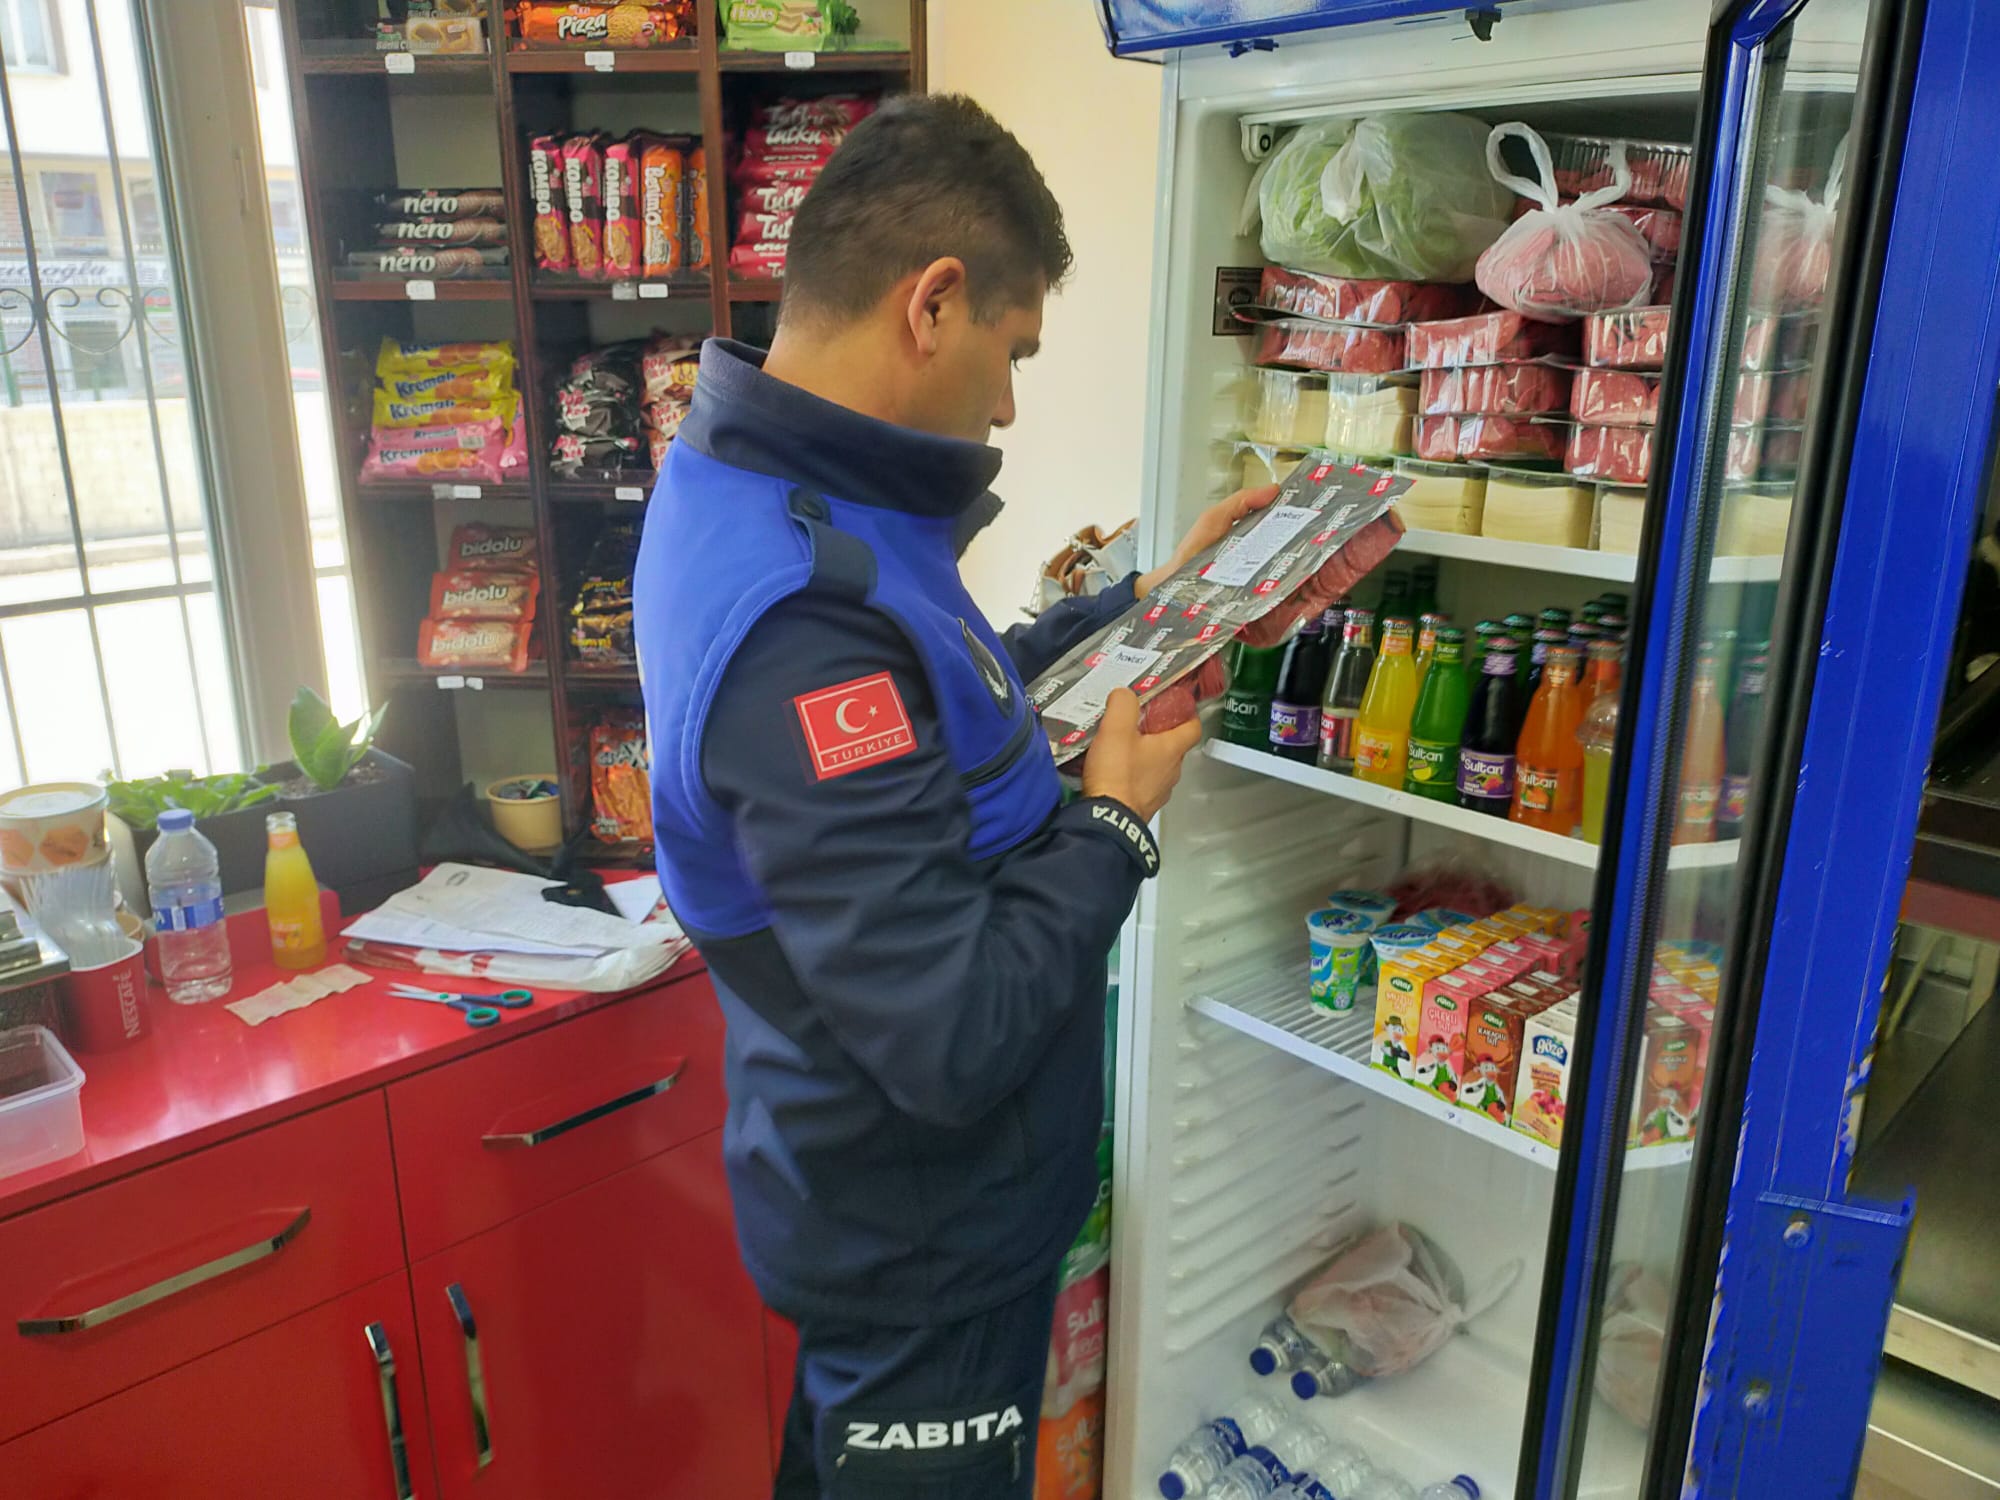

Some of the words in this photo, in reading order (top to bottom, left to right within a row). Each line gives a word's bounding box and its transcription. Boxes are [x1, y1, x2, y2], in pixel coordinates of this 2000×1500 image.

[557, 13, 607, 40] Pizza
[531, 149, 552, 215] KOMBO
[565, 157, 584, 224] KOMBO
[605, 157, 622, 222] KOMBO
[403, 197, 459, 214] nero
[756, 186, 806, 212] Tutk
[397, 222, 455, 240] nero
[379, 254, 437, 273] nero
[461, 537, 523, 557] bidolu
[443, 584, 508, 606] bidolu
[1224, 697, 1258, 716] ultan
[1271, 708, 1297, 724] ultan
[1408, 744, 1444, 762] Sultan
[1463, 757, 1504, 774] Sultan
[1519, 767, 1558, 789] Sultan
[1092, 805, 1157, 870] ZABITA
[846, 1404, 1024, 1451] ZABITA
